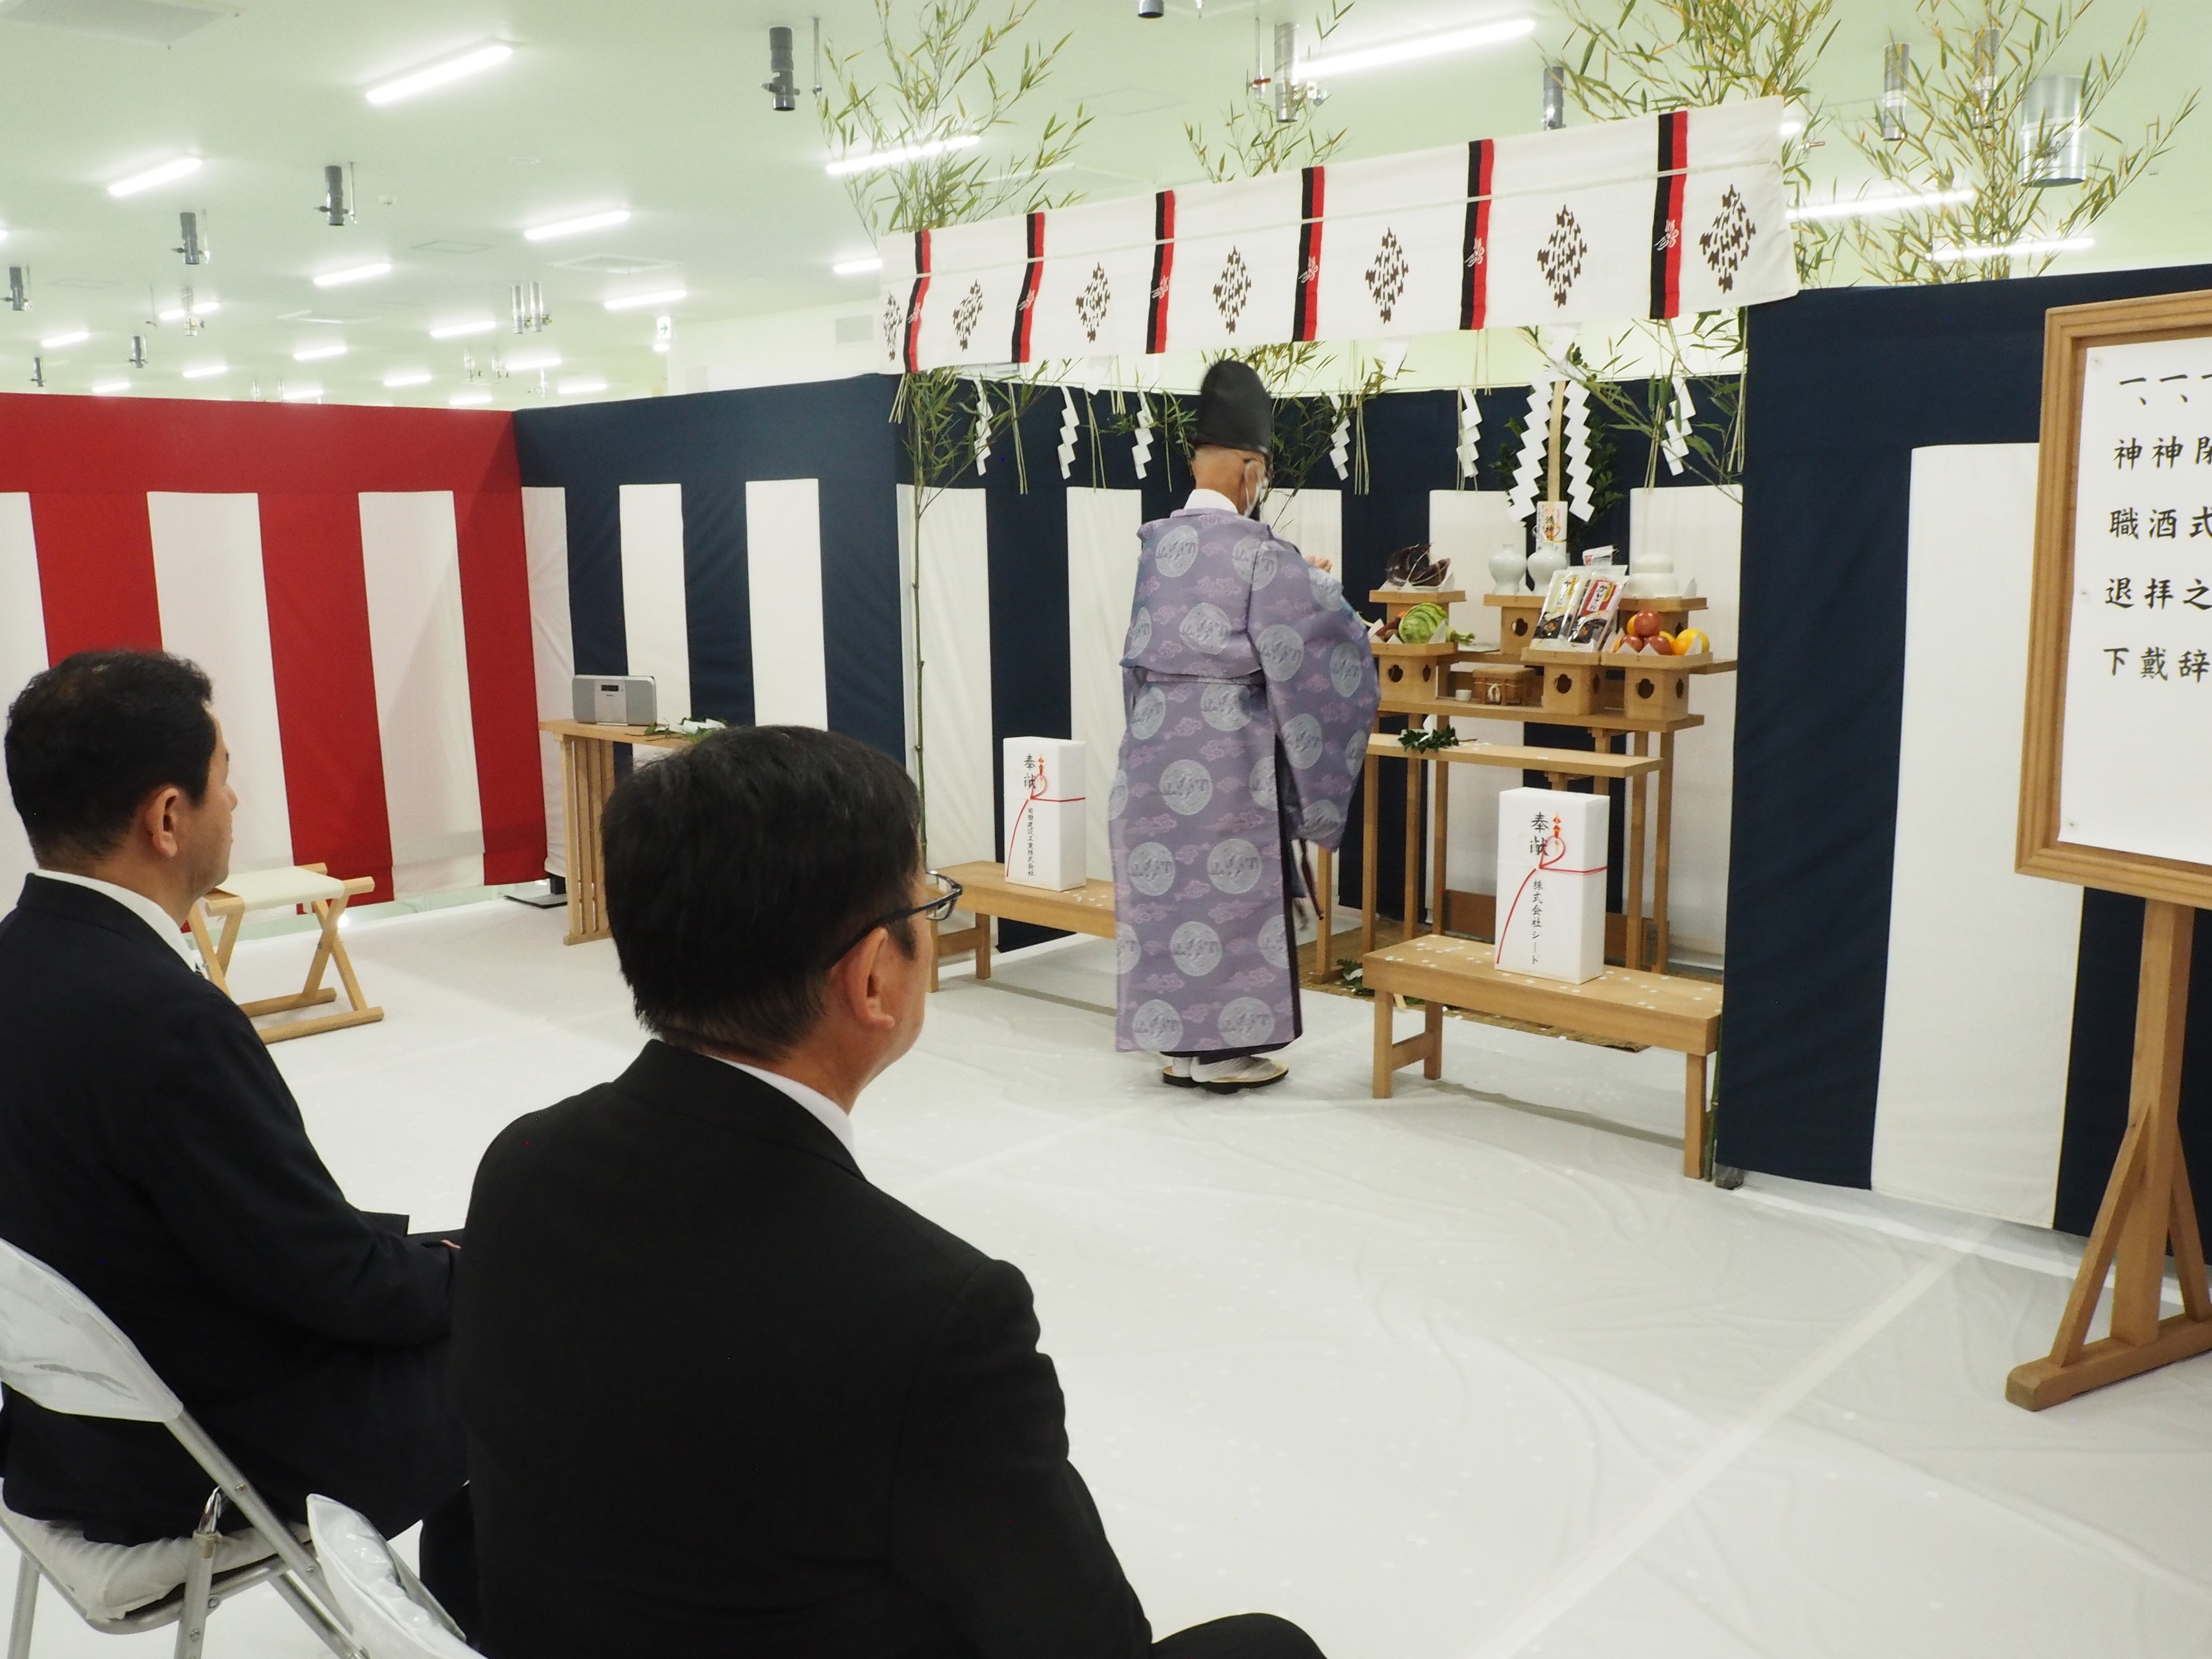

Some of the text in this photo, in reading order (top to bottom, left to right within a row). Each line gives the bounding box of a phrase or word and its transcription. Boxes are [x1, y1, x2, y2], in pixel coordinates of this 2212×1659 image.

[2103, 377, 2147, 676] 一、神職退下
[2141, 374, 2189, 681] 一、神酒拝戴
[1531, 879, 1544, 965] 株式会社シード
